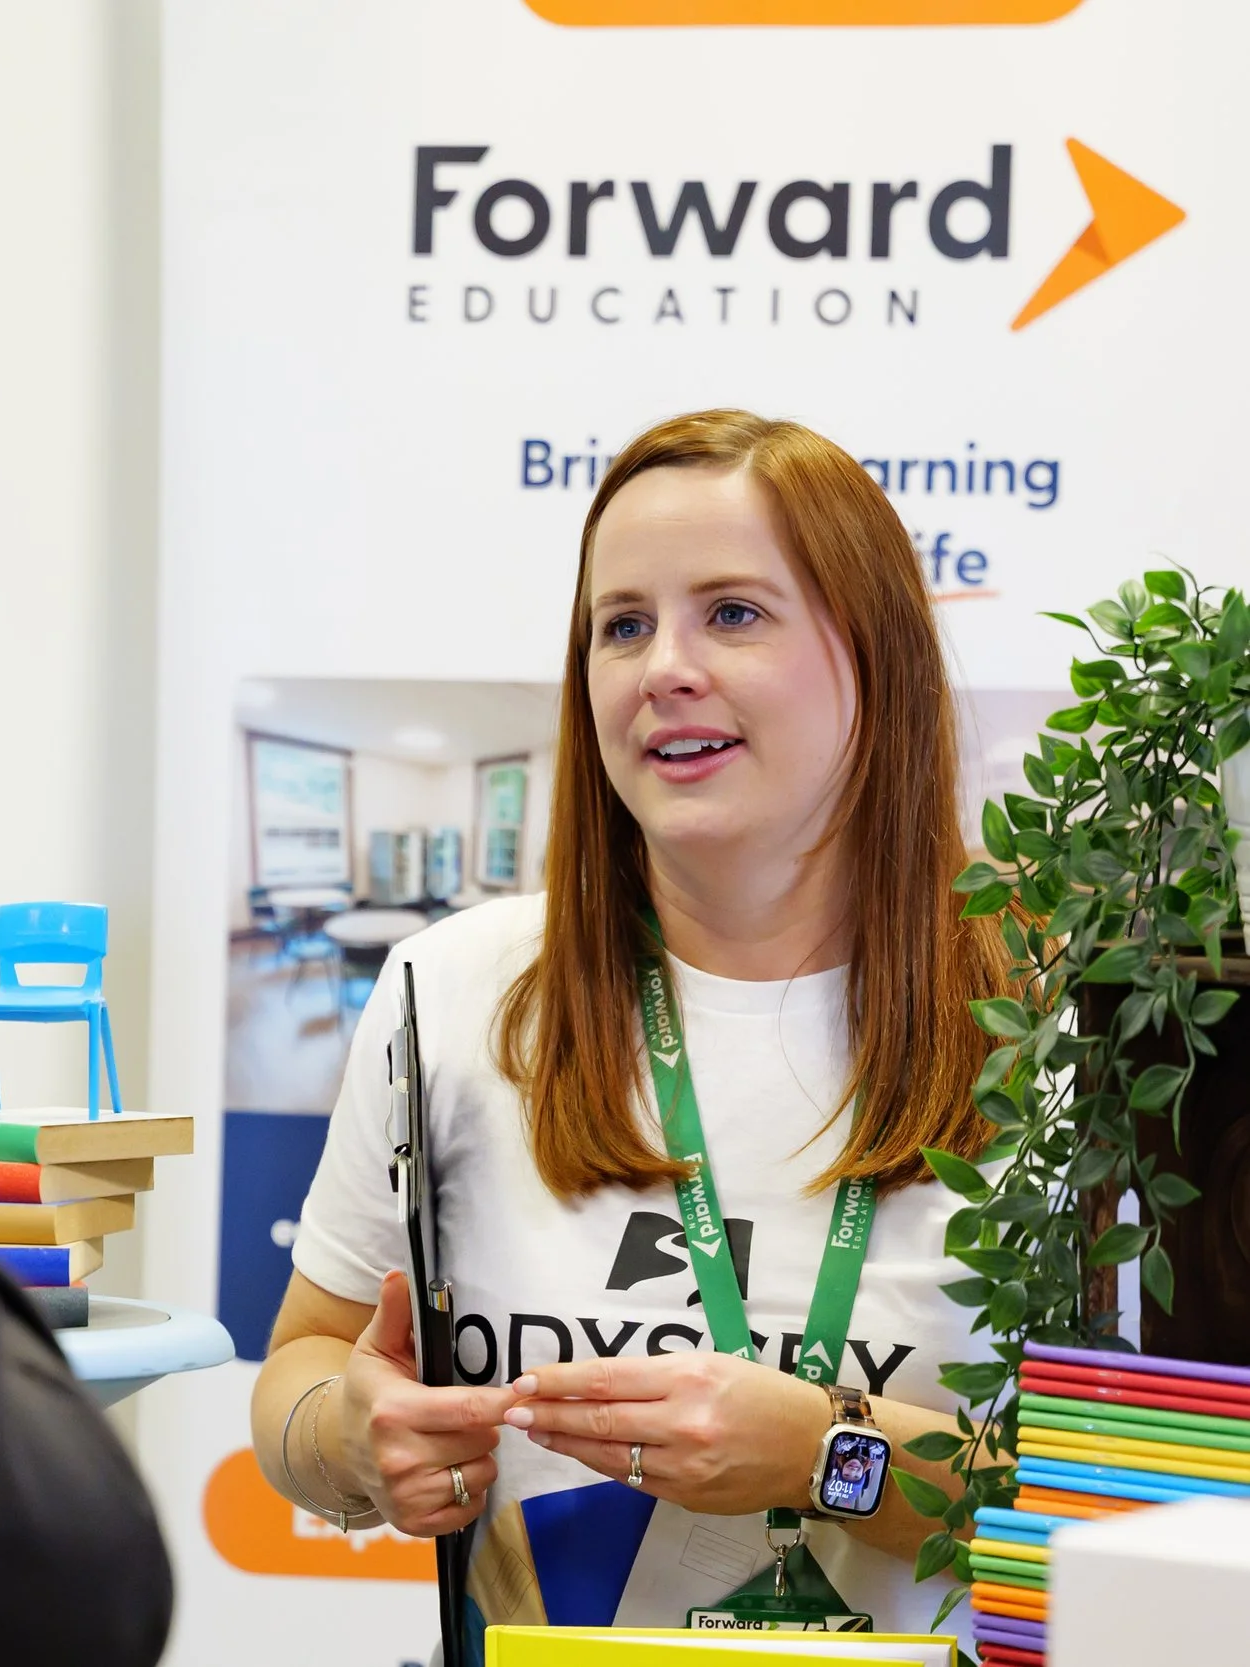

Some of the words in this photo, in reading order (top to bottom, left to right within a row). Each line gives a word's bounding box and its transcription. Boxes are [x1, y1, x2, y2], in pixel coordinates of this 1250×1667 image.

[413, 144, 1013, 259] Forward
[406, 285, 920, 325] EDUCATION
[859, 441, 1059, 509] arning
[679, 1182, 696, 1229] CATION
[831, 1178, 863, 1248] Forwar
[454, 1313, 916, 1397] ODYY
[828, 1480, 854, 1494] 11:07
